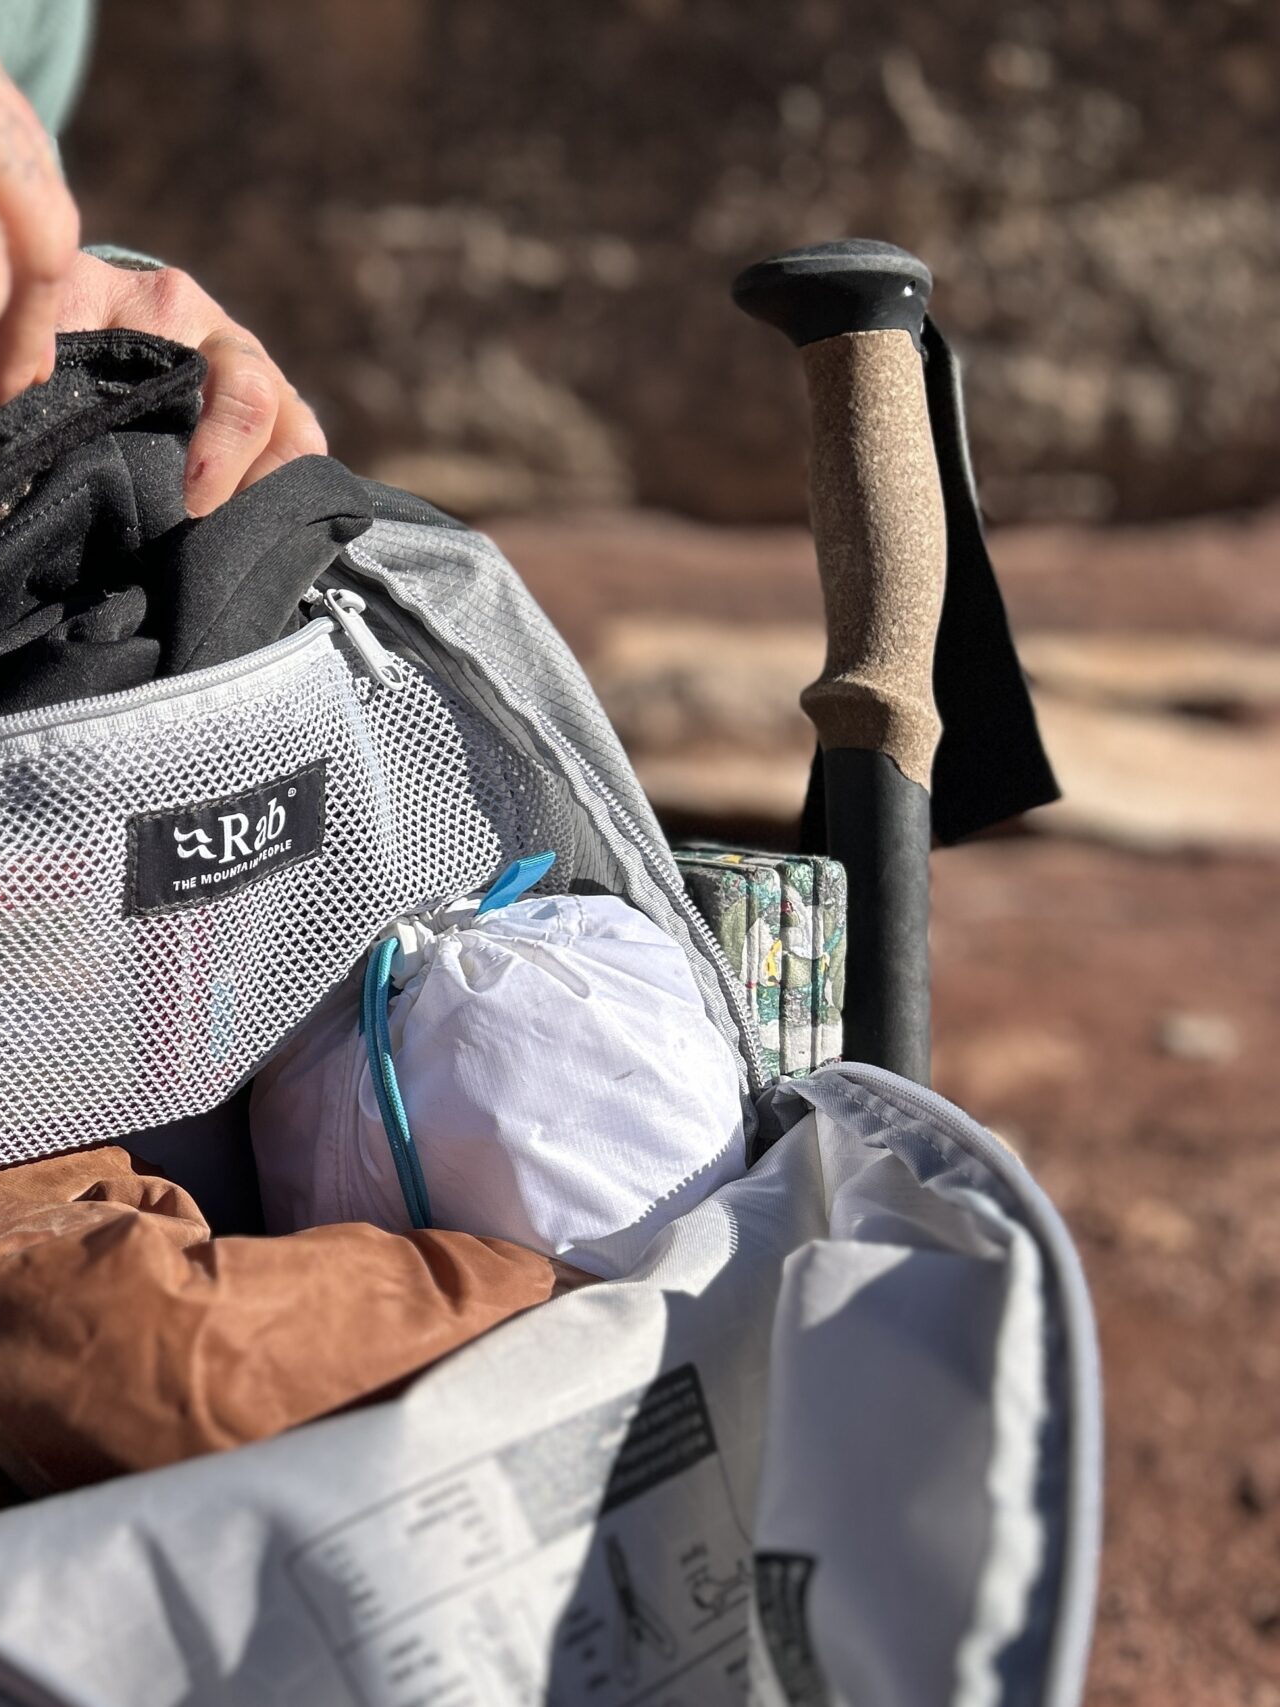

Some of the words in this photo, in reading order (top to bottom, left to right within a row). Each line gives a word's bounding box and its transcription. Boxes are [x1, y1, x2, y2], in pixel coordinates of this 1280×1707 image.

[218, 797, 287, 864] Rab
[173, 876, 198, 892] THE
[200, 857, 259, 885] MOUNTAIN
